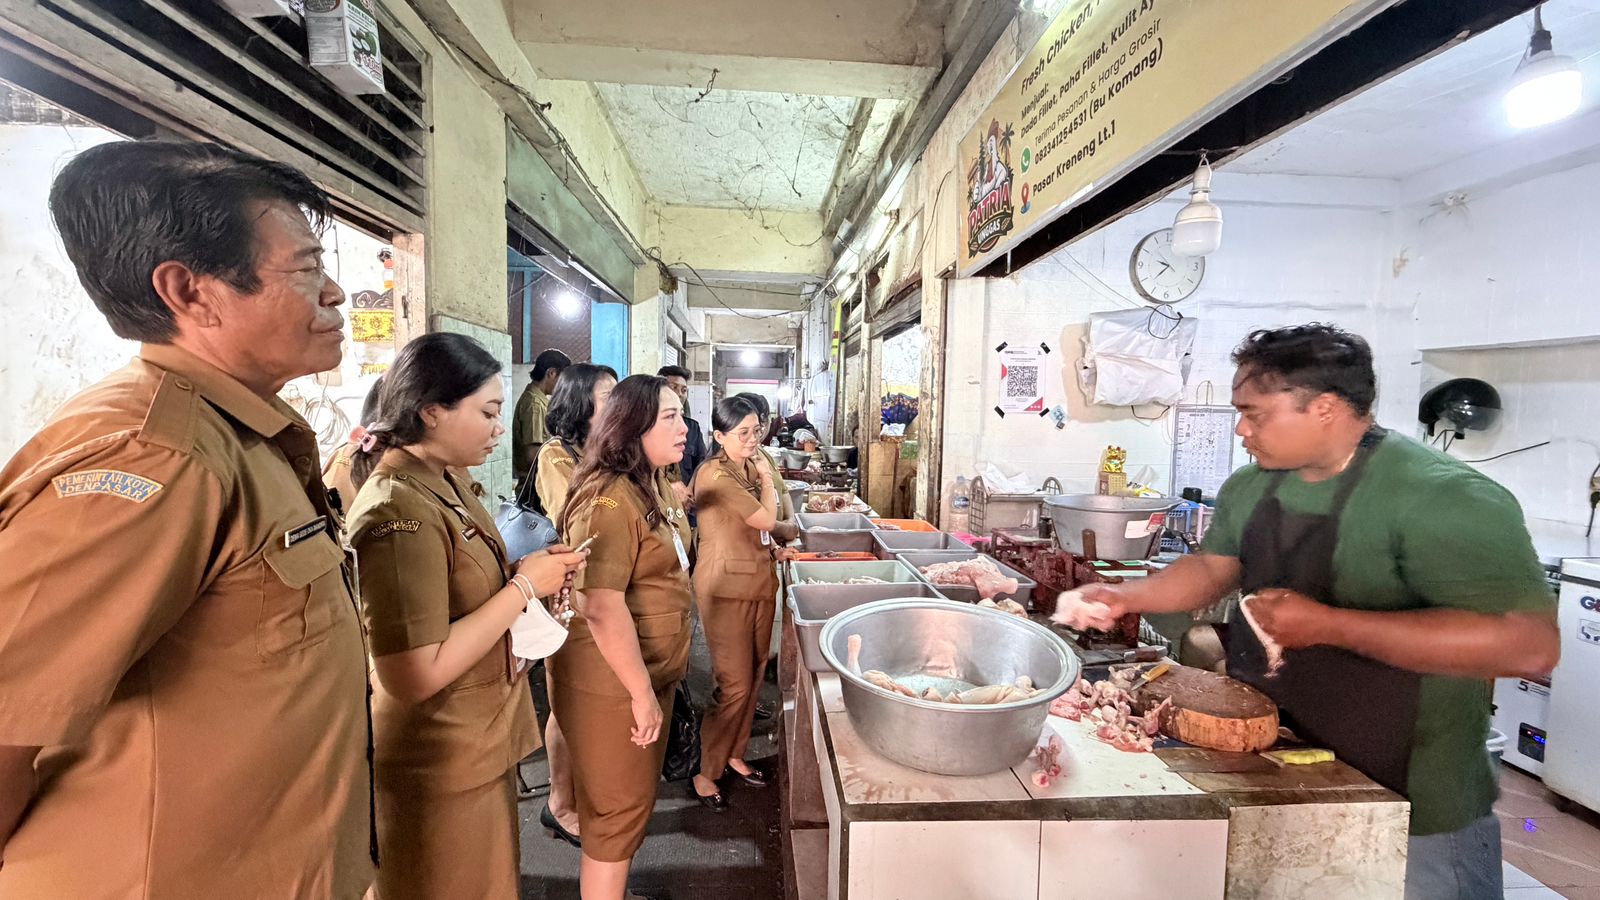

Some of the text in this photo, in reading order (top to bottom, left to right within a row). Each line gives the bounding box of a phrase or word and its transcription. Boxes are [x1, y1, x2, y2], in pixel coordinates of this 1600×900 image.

[1020, 115, 1038, 138] Dada
[1059, 70, 1081, 98] Paha
[1082, 42, 1108, 75] Fillet,
[1110, 8, 1137, 46] Kulit
[1021, 5, 1093, 95] Fresh Chicken,
[1089, 92, 1106, 119] (Bu
[1107, 37, 1163, 101] Komang)
[1021, 83, 1049, 120] Menjual:
[1035, 18, 1161, 147] Terima Pesanan & Harga Grosir
[1033, 171, 1055, 197] Pasar
[1056, 138, 1096, 179] Kreneng
[968, 181, 1011, 241] PATRIA
[1163, 290, 1169, 298] 6
[1193, 262, 1199, 271] 3
[59, 472, 156, 496] PEMERINTAH KOTA
[66, 482, 143, 500] DENPASAR
